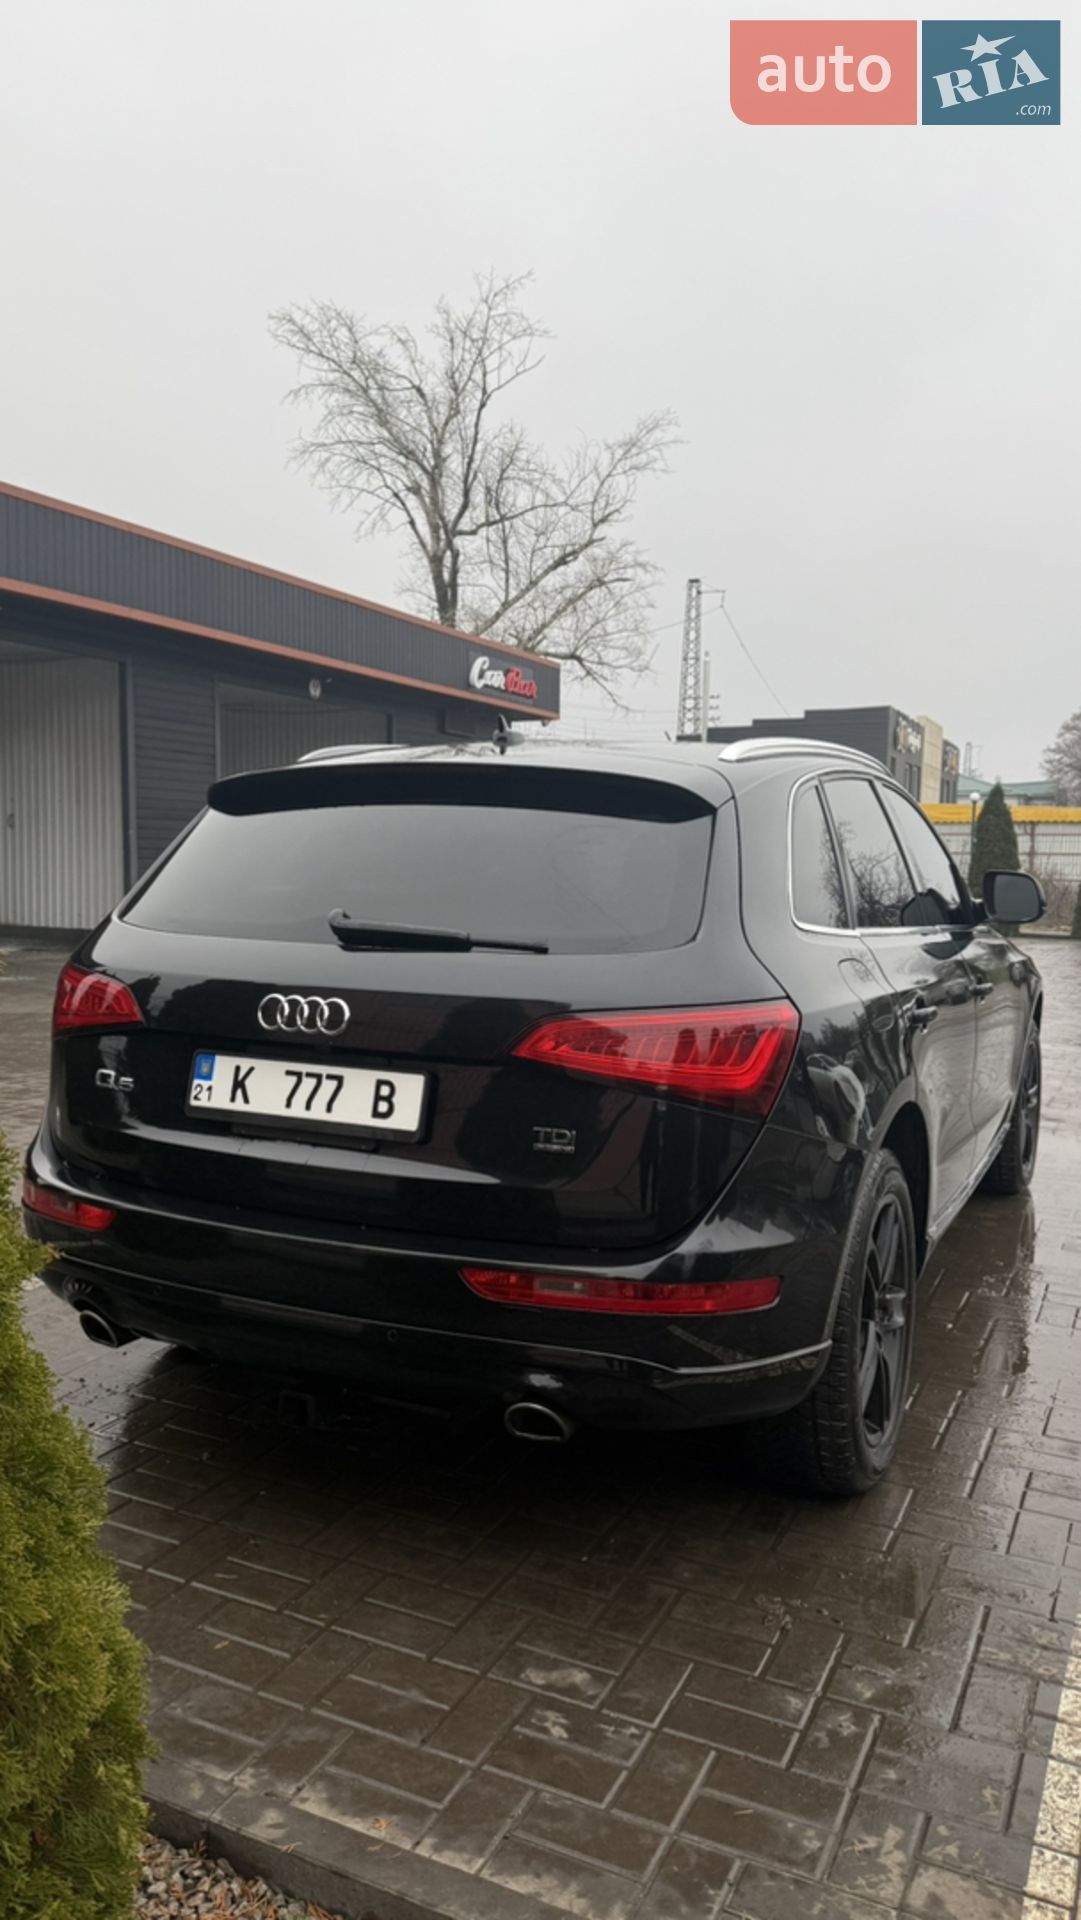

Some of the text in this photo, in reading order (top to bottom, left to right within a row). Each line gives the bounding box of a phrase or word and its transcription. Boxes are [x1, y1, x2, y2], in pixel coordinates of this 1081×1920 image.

[95, 1068, 134, 1092] Q5
[193, 1083, 213, 1102] 21
[230, 1064, 397, 1120] K 777 B
[533, 1126, 577, 1146] TDI
